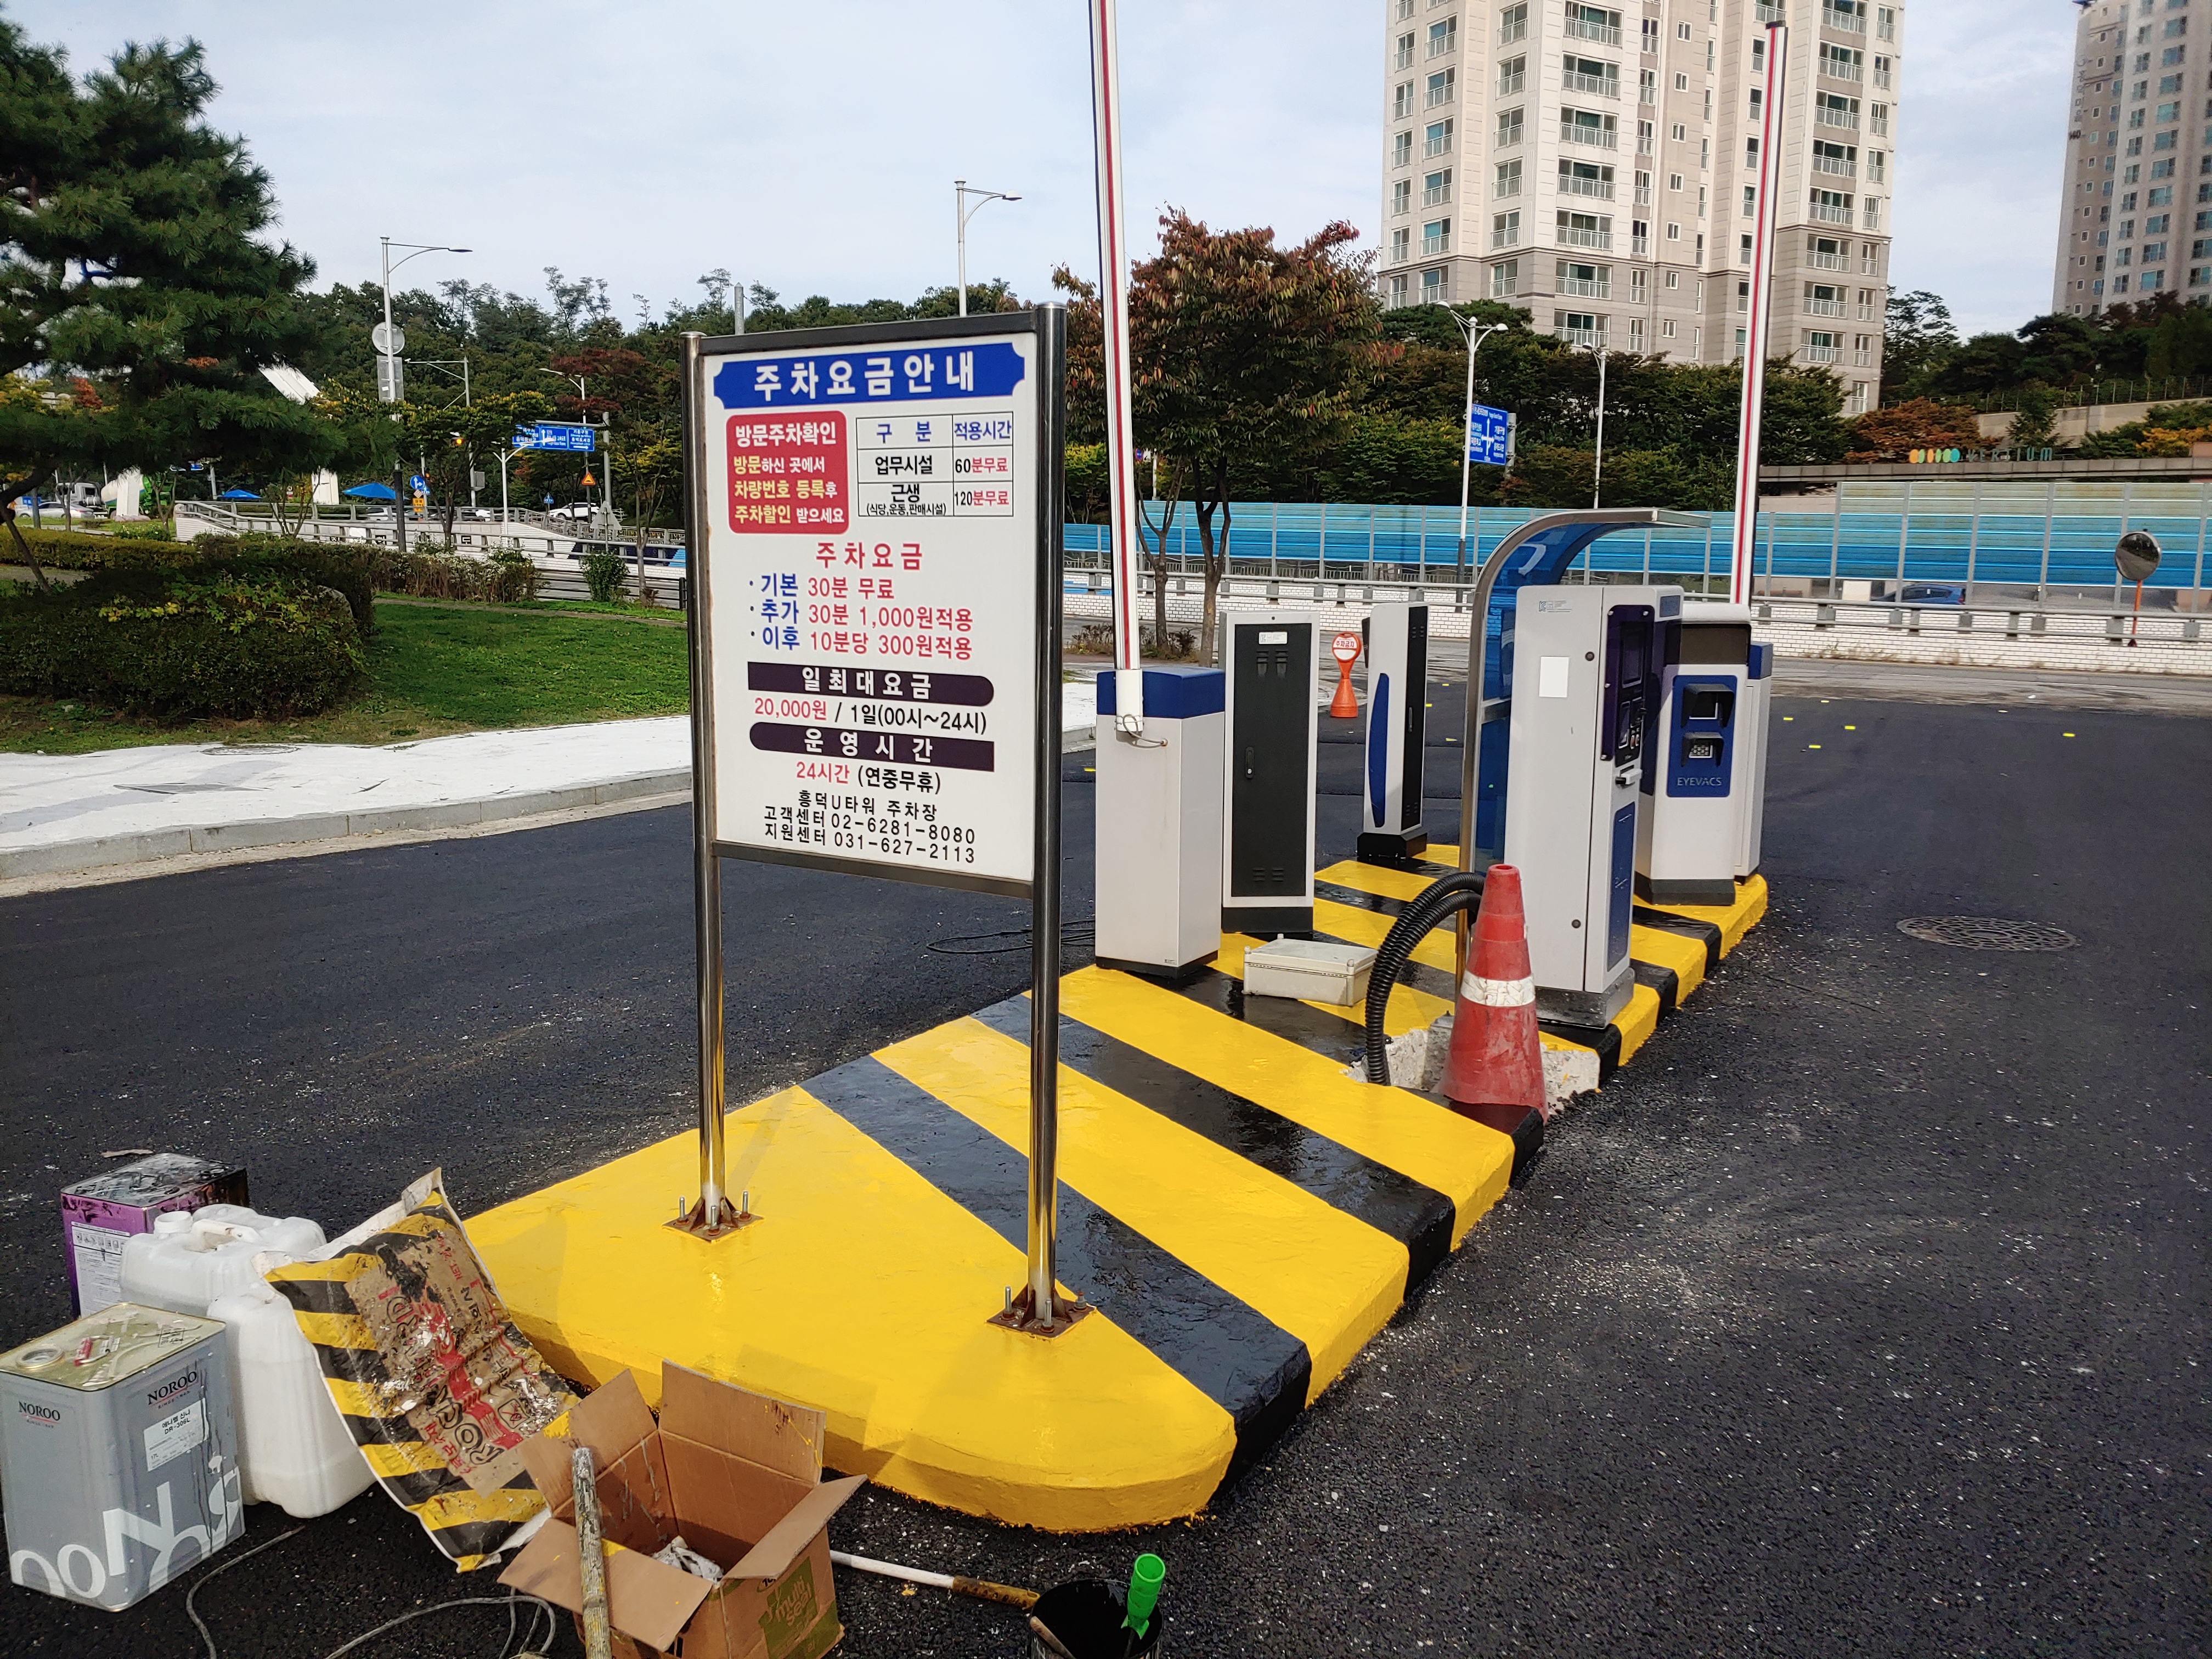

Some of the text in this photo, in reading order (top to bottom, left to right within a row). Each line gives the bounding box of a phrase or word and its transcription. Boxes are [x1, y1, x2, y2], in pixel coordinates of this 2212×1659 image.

[735, 421, 837, 448] 방문주차확인
[953, 420, 1012, 441] 적용시간
[733, 455, 826, 475] 방문하신 곳에서
[874, 455, 933, 476] 업무시설
[955, 457, 1008, 473] 60분무료
[733, 479, 838, 500] 차량번호 등록후
[890, 484, 921, 503] 근생
[953, 491, 1009, 507] 120분무료
[734, 505, 845, 524] 주차할인 받으세요
[815, 541, 923, 570] 주차요금
[760, 572, 895, 601] 기본 30분 무료
[760, 599, 973, 632] 추가 30분 1,000원적용
[762, 625, 973, 660] 이후 10분당 300원적용
[802, 666, 932, 700] 일최대요금
[754, 697, 827, 721] 20,000원
[796, 761, 941, 795] 24시간 (연중무휴)
[1677, 777, 1723, 786] EYEVACS
[798, 789, 938, 822] 흥덕U타워 주차장
[763, 805, 975, 845] 고객센터 02-6281-8080
[764, 822, 975, 864] 지원센터 031-627-2113
[146, 1371, 198, 1406] NOROO
[18, 1400, 61, 1421] NOROO
